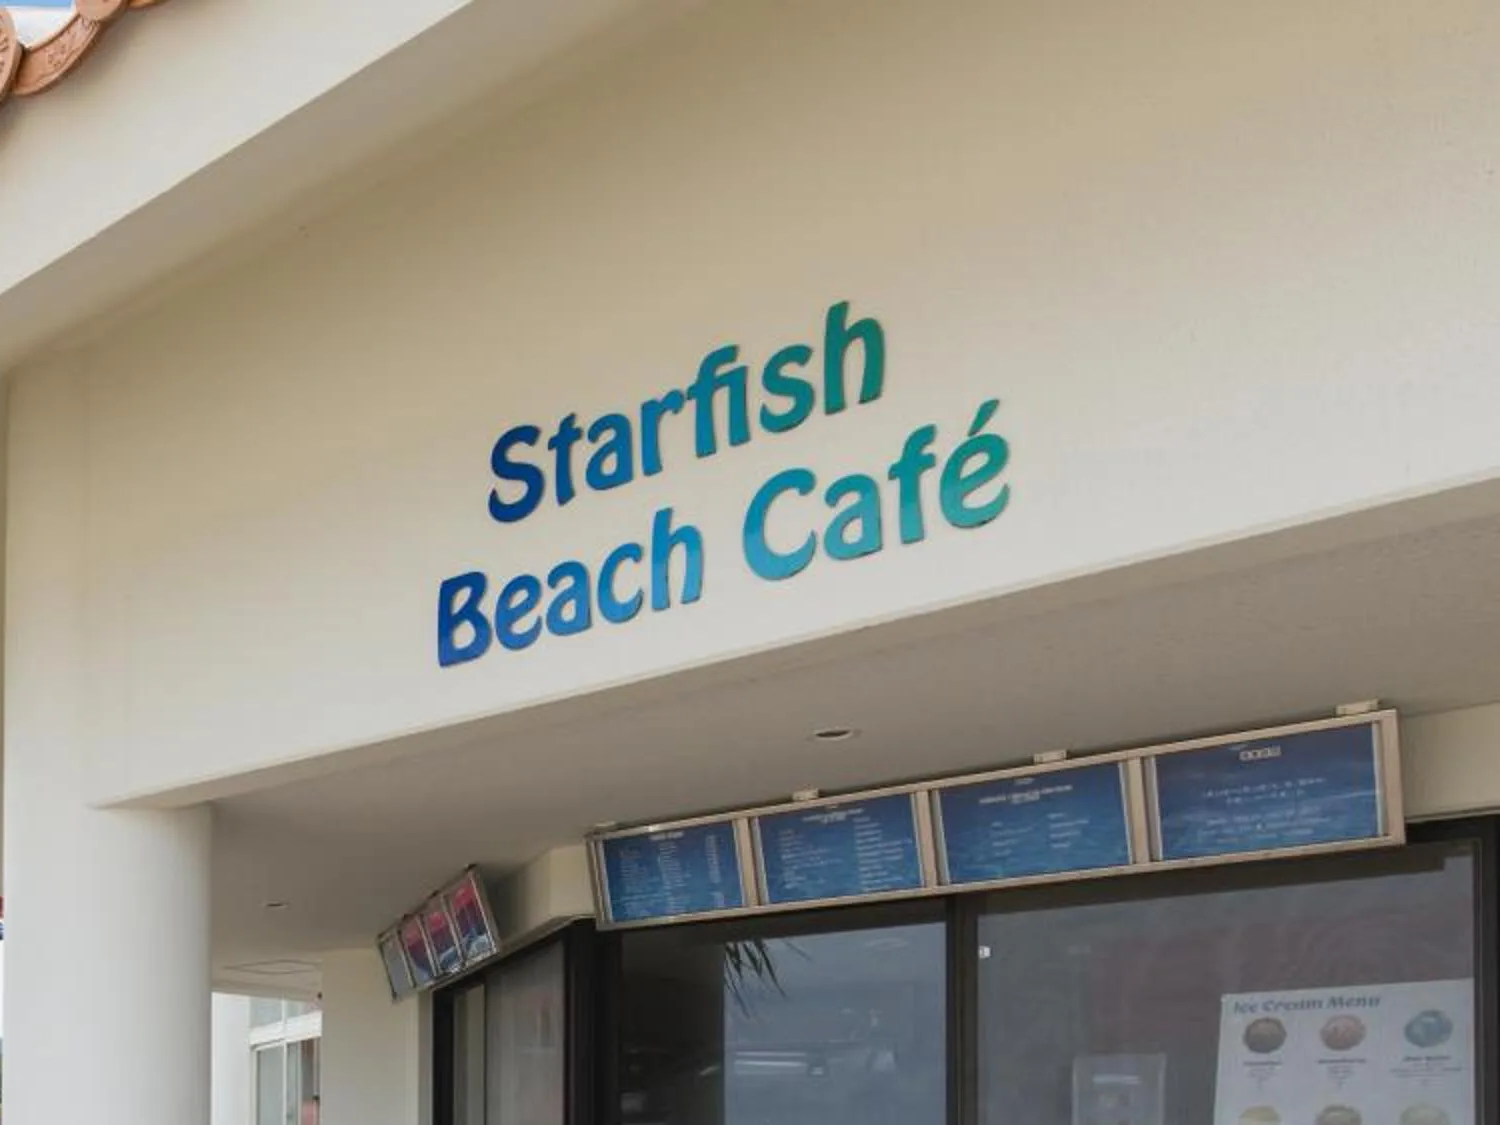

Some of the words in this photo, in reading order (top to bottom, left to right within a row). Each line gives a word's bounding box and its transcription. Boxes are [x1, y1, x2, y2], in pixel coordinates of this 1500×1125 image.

[488, 301, 886, 524] Starfish
[437, 508, 705, 667] Beach
[743, 399, 1011, 582] Café
[1233, 1000, 1258, 1015] Ice
[1261, 997, 1323, 1012] Cream
[1326, 995, 1381, 1009] Menu
